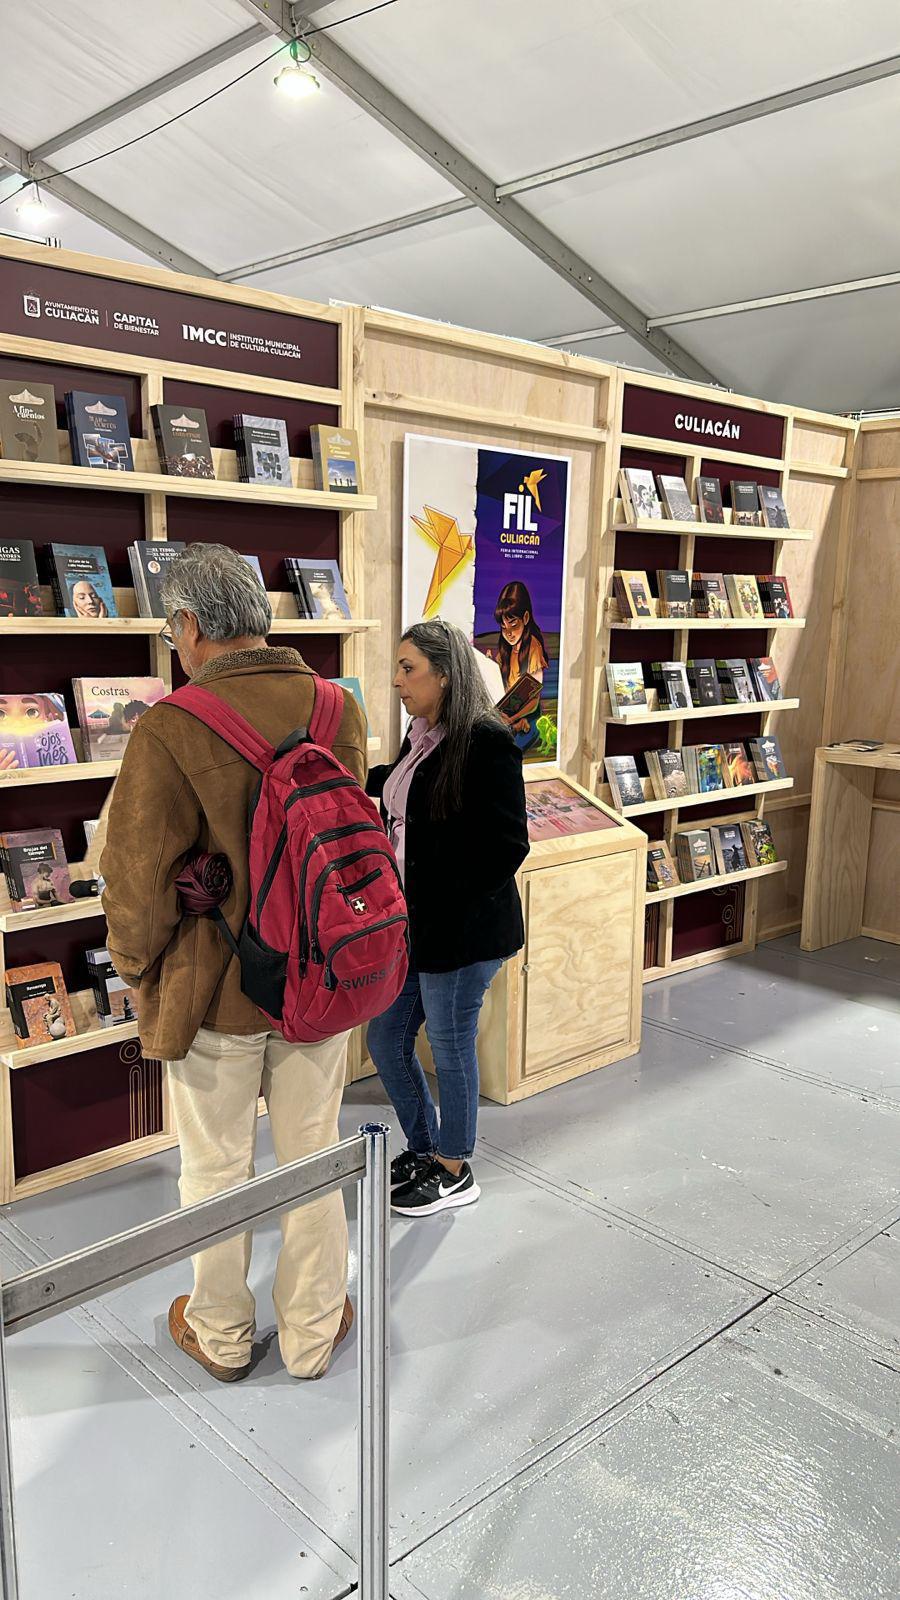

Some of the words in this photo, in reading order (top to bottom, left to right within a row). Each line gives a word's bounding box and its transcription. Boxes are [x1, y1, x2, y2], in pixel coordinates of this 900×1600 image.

[45, 301, 90, 314] AYUNTAMIENTO
[45, 307, 100, 324] CULIACÁN
[113, 312, 159, 328] CAPITAL
[113, 322, 124, 330] DE
[124, 324, 160, 336] BIENESTAR
[182, 324, 227, 347] IMCC
[229, 333, 264, 345] INSTITUTO
[265, 339, 301, 352] MUNICIPAL
[229, 340, 240, 348] DE
[240, 342, 270, 353] CULTURA
[270, 347, 301, 359] CULIACÁN
[674, 413, 740, 440] CULIACÁN
[91, 685, 130, 697] Costras
[41, 731, 61, 752] ojos
[341, 968, 386, 991] SWISS
